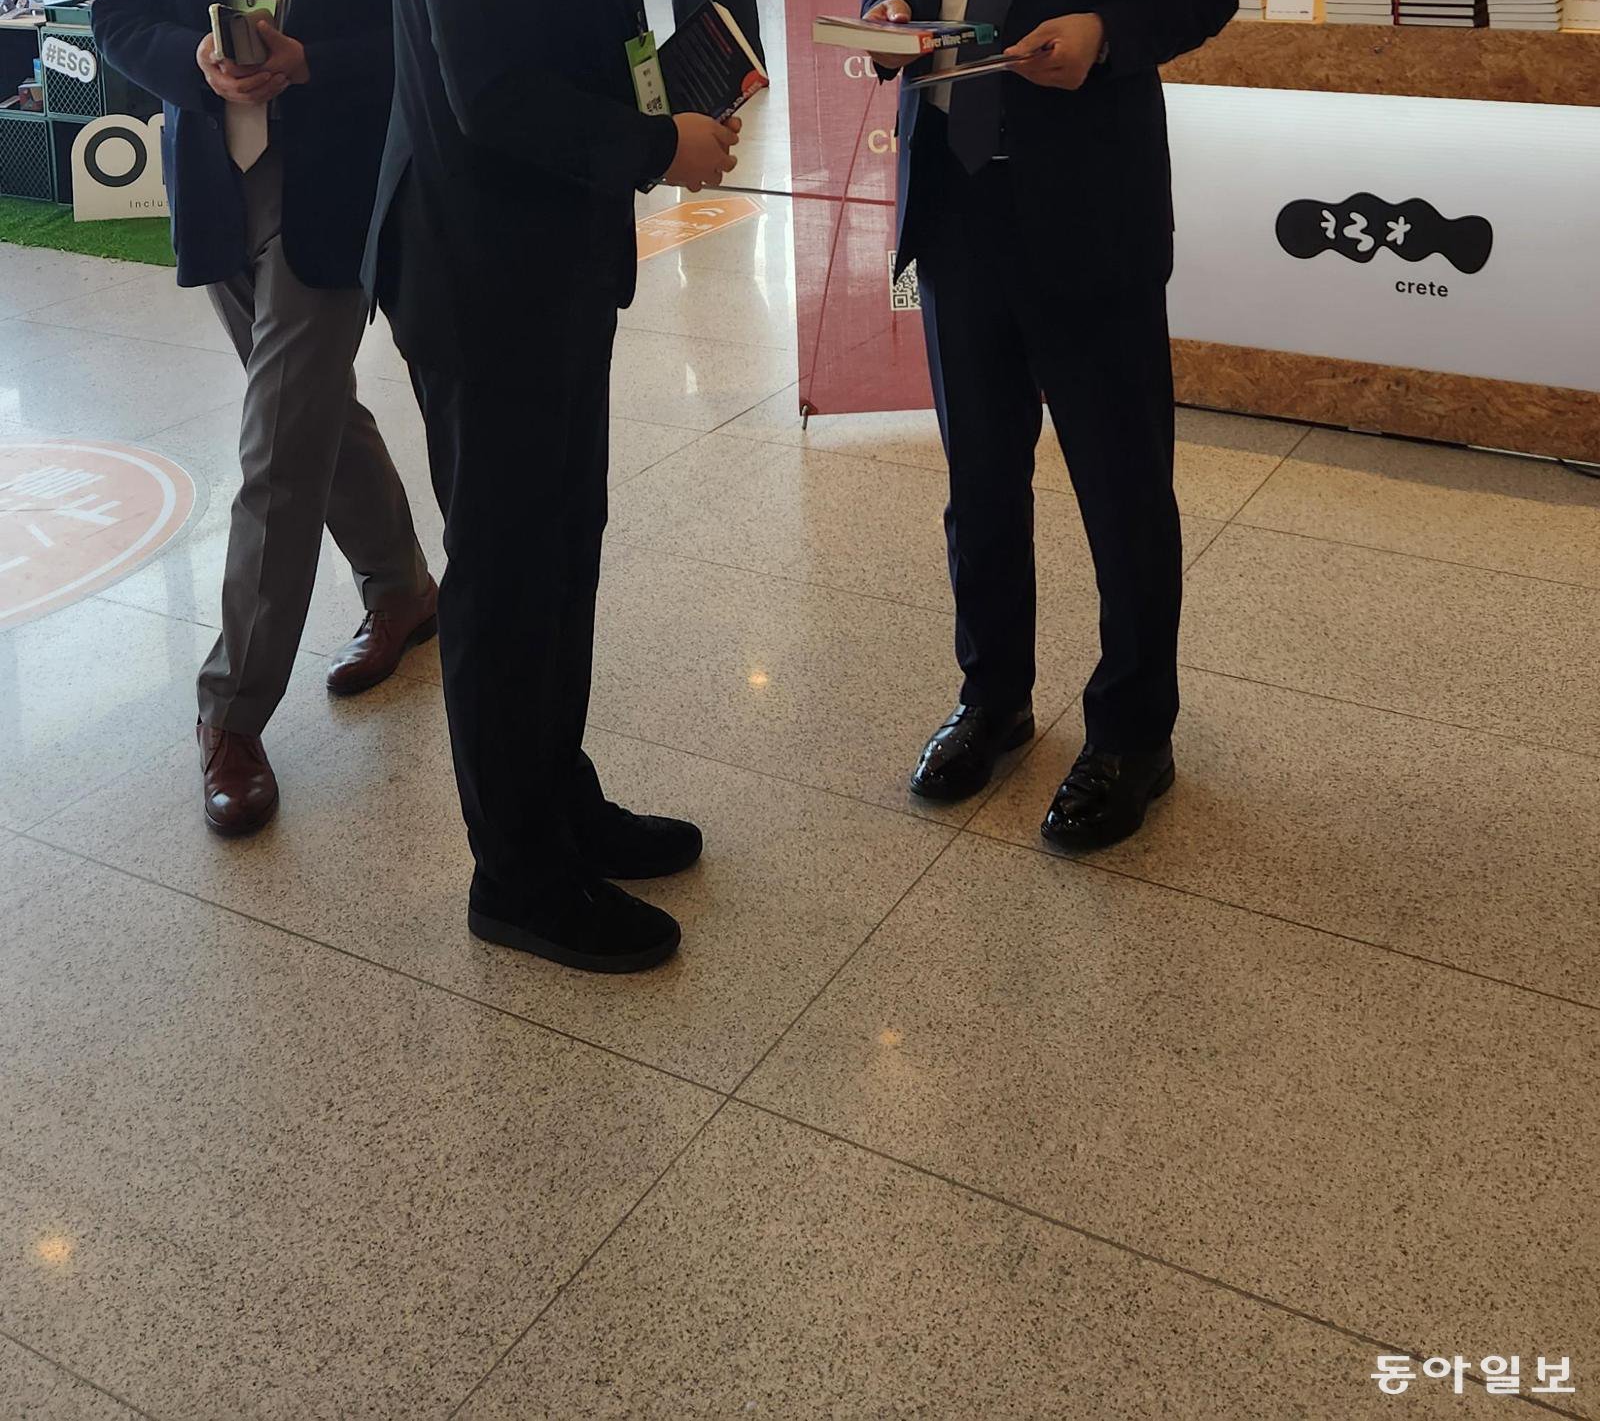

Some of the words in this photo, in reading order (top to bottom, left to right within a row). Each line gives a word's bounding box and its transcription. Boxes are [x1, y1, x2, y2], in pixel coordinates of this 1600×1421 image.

[922, 36, 941, 49] Silver
[941, 34, 961, 46] Wave
[45, 43, 91, 77] #ESG
[130, 197, 169, 208] Inclu
[1395, 280, 1448, 298] crete
